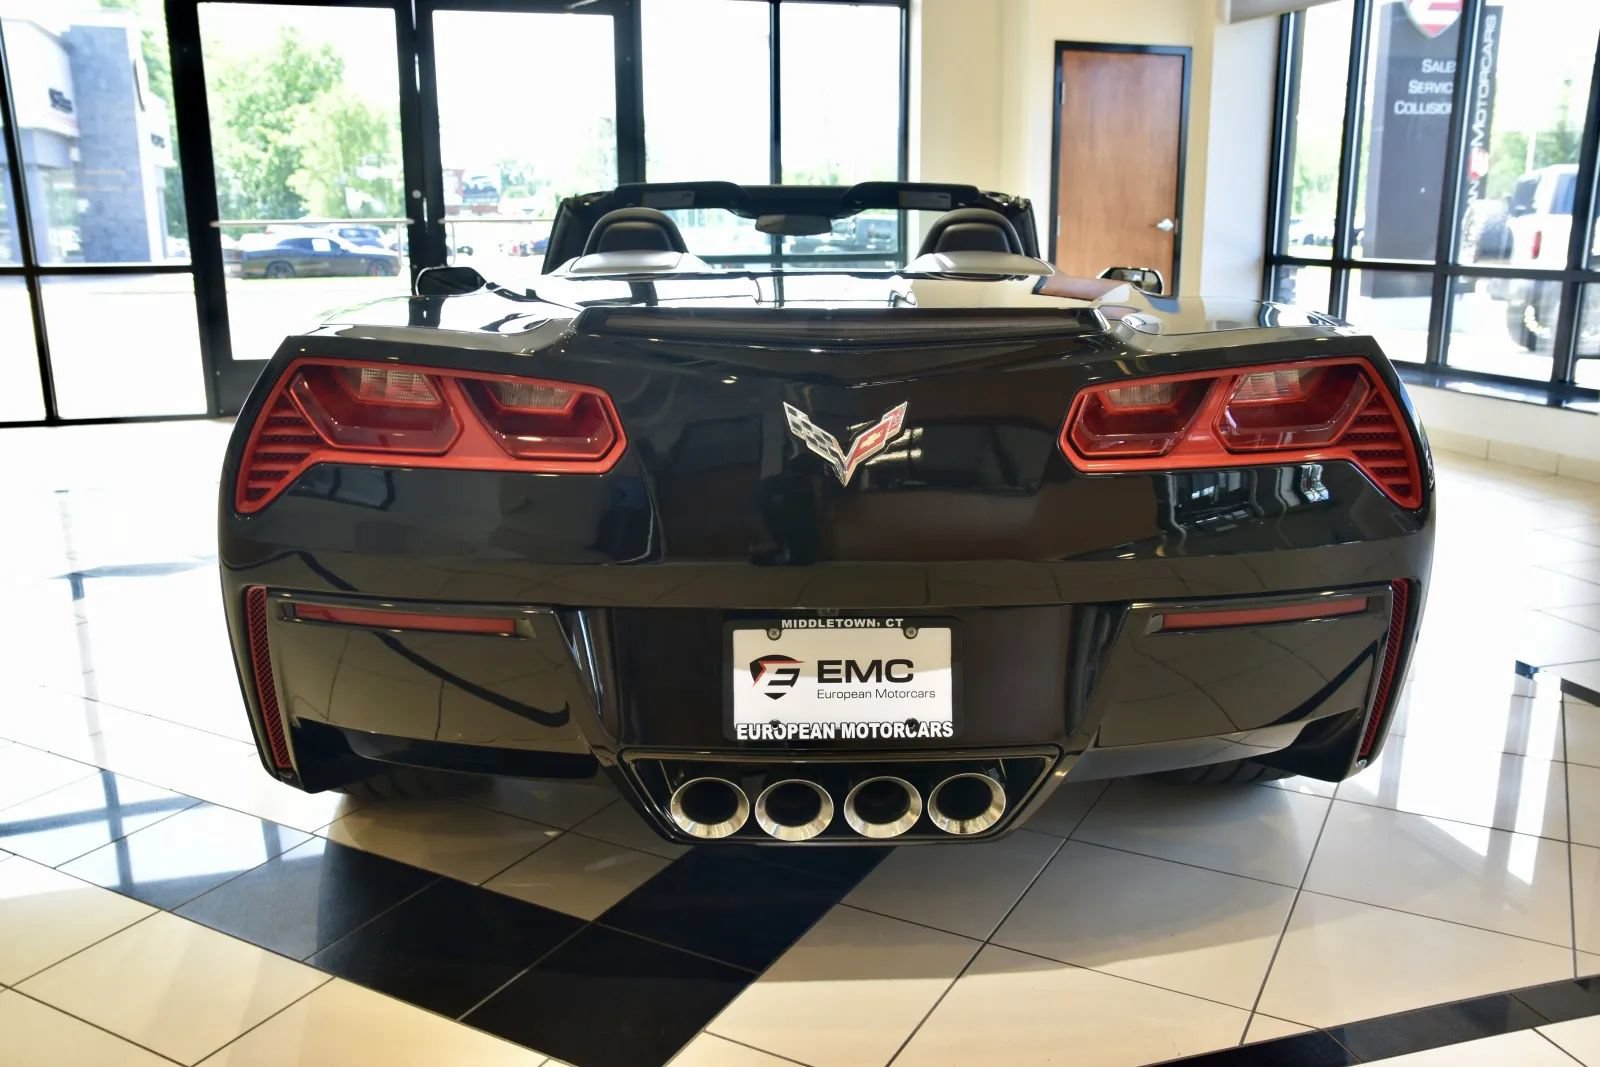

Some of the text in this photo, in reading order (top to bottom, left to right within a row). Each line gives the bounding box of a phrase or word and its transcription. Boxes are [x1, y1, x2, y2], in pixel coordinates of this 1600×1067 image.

[1422, 58, 1456, 73] SALE
[1408, 79, 1454, 94] SERVIC
[1470, 15, 1497, 147] MOTORCARS
[781, 618, 904, 629] MIDDLETOWN, CT
[817, 659, 914, 684] EMC
[817, 688, 936, 700] European Motorcars
[736, 721, 954, 740] EUROPEAN MOTORCARS
